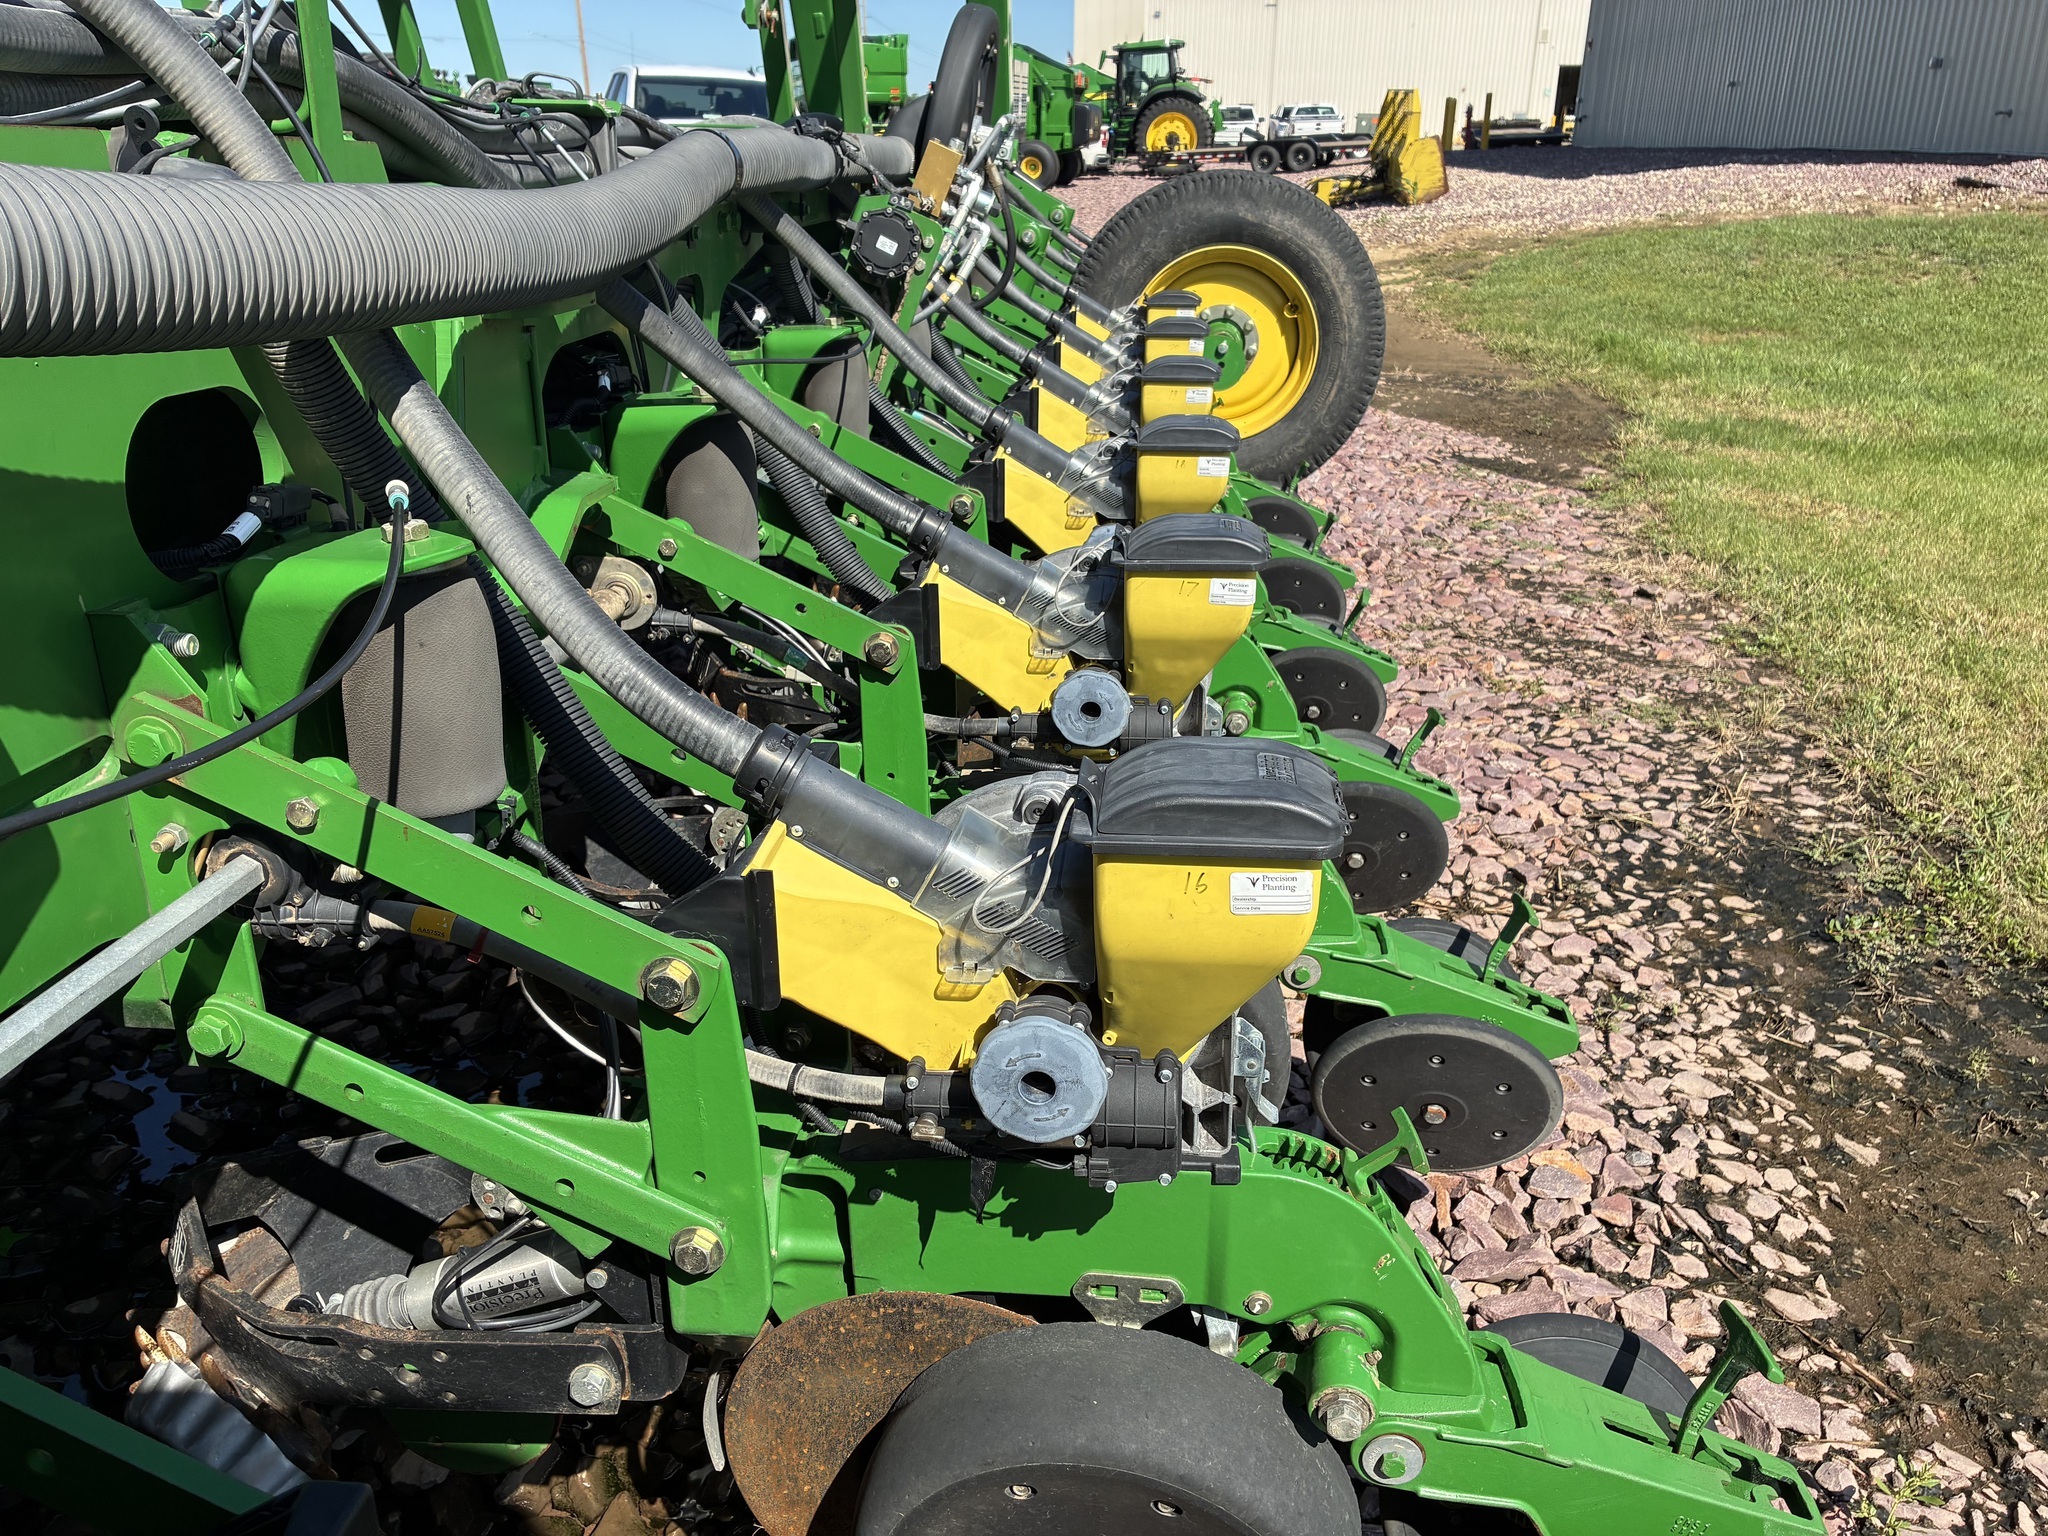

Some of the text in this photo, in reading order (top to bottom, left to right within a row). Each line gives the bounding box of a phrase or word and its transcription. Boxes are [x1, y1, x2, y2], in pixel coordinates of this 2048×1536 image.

[1178, 580, 1200, 597] 17
[1183, 871, 1208, 895] 16
[1262, 874, 1298, 882] Precision
[1262, 883, 1297, 893] Planting
[466, 1269, 538, 1295] PLANTIN
